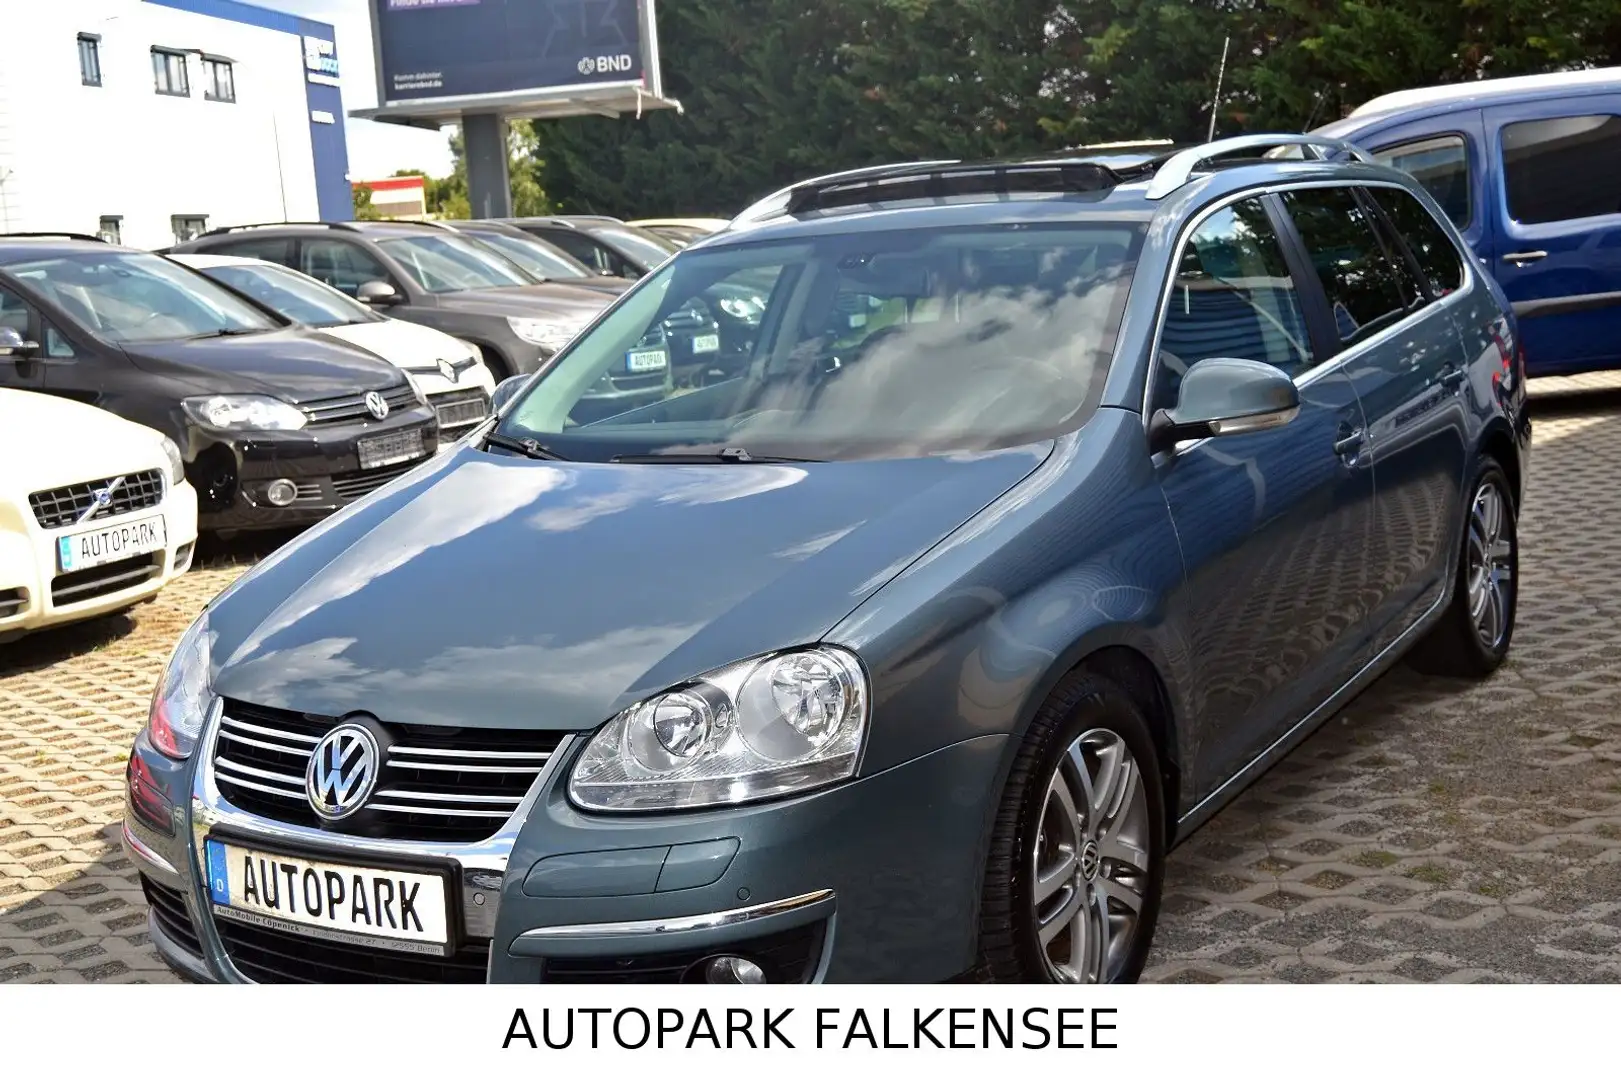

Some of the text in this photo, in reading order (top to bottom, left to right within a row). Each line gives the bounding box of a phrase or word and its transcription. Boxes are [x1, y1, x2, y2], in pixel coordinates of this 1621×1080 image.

[596, 54, 632, 73] BND
[82, 522, 157, 559] AUTOPARK
[244, 855, 424, 932] AUTOPARK
